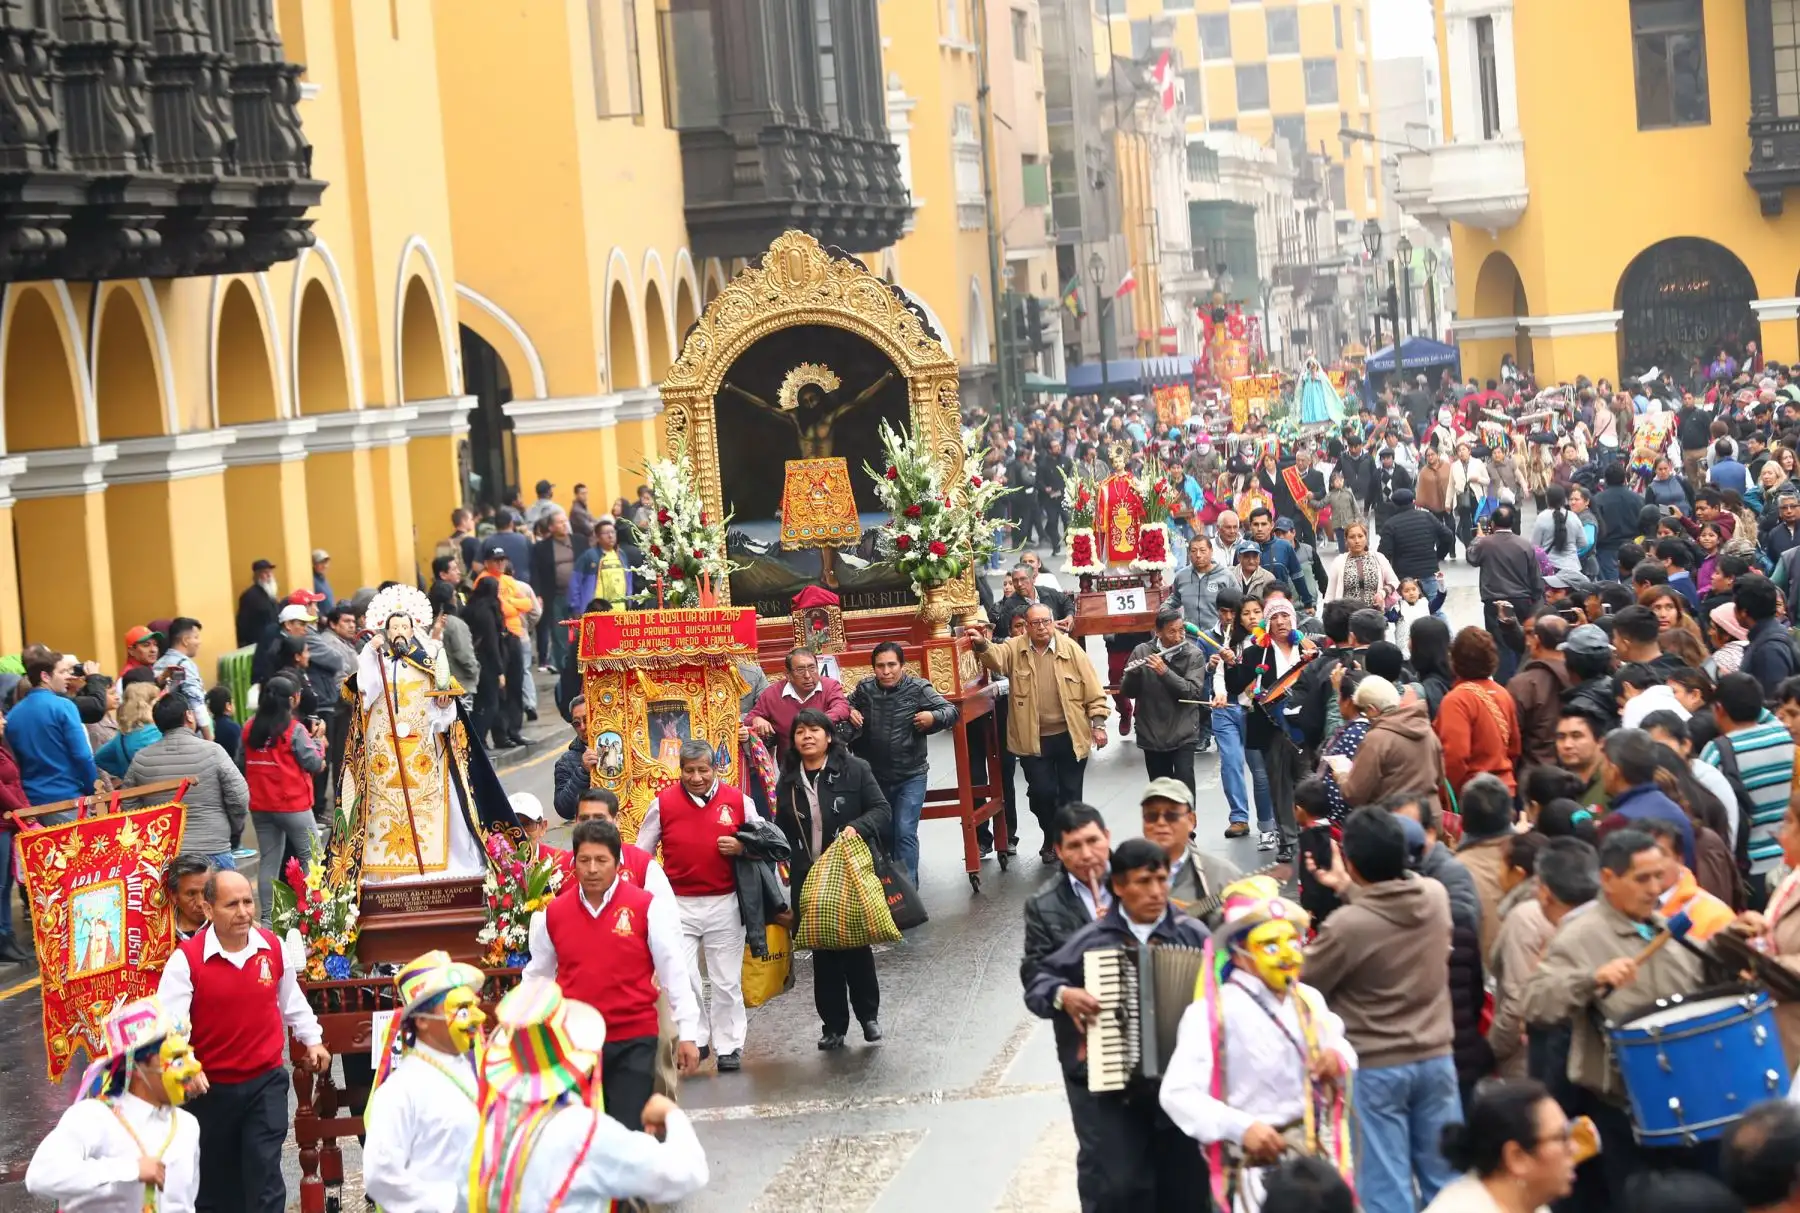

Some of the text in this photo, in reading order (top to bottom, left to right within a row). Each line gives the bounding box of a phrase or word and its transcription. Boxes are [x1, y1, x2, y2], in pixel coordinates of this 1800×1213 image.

[1116, 594, 1135, 610] 35
[645, 612, 656, 625] DE
[721, 609, 741, 621] 2019
[622, 624, 731, 637] CLUB PROVINCIAL QUISPICANCHI
[637, 636, 671, 648] SANTIAGO
[675, 635, 700, 647] OVIEDO
[710, 634, 735, 645] FAMILIA
[70, 864, 122, 889] ABAD DE
[432, 888, 443, 896] DE
[127, 927, 142, 966] CUSCO
